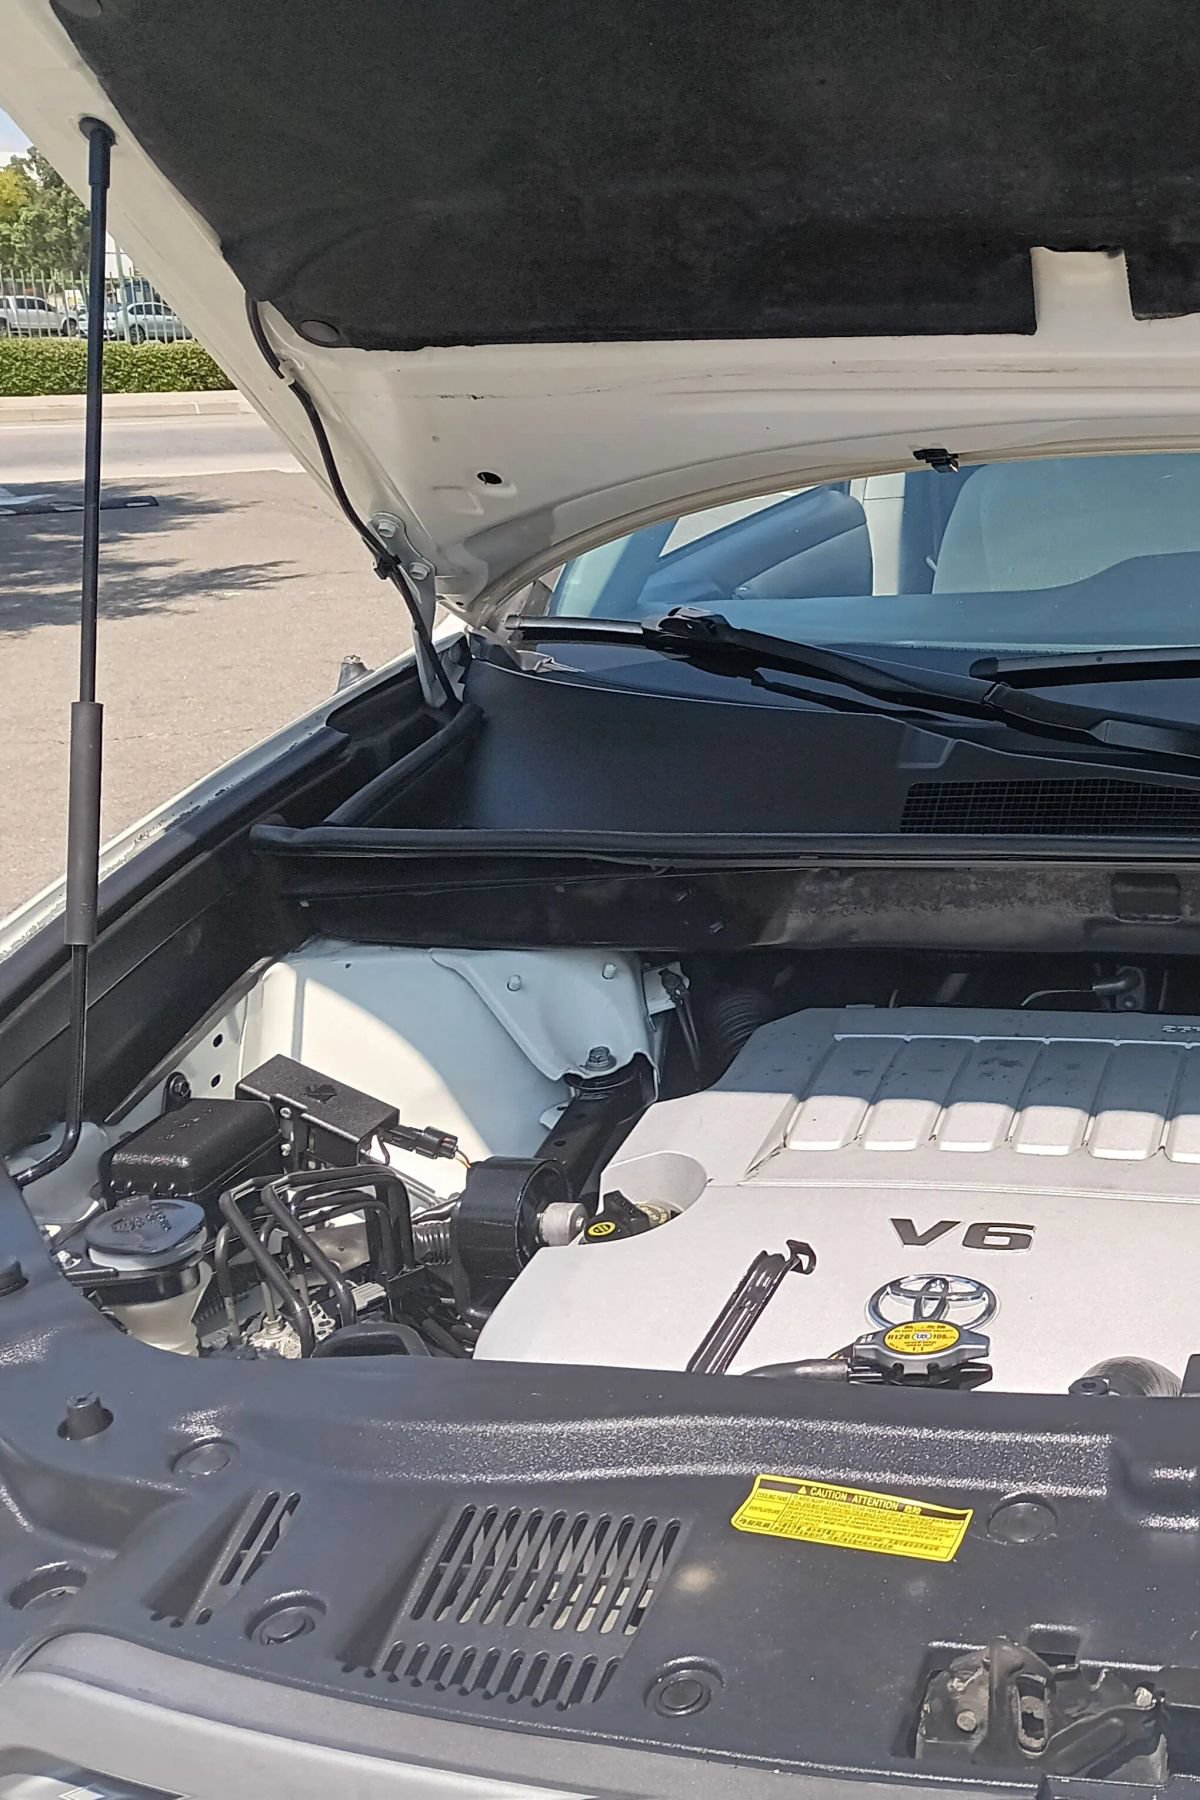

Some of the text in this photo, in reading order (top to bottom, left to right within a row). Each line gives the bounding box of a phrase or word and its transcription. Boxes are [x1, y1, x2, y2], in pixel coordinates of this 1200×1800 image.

[890, 1218, 1036, 1250] V6
[811, 1487, 899, 1511] CAUTION ATTENTION
